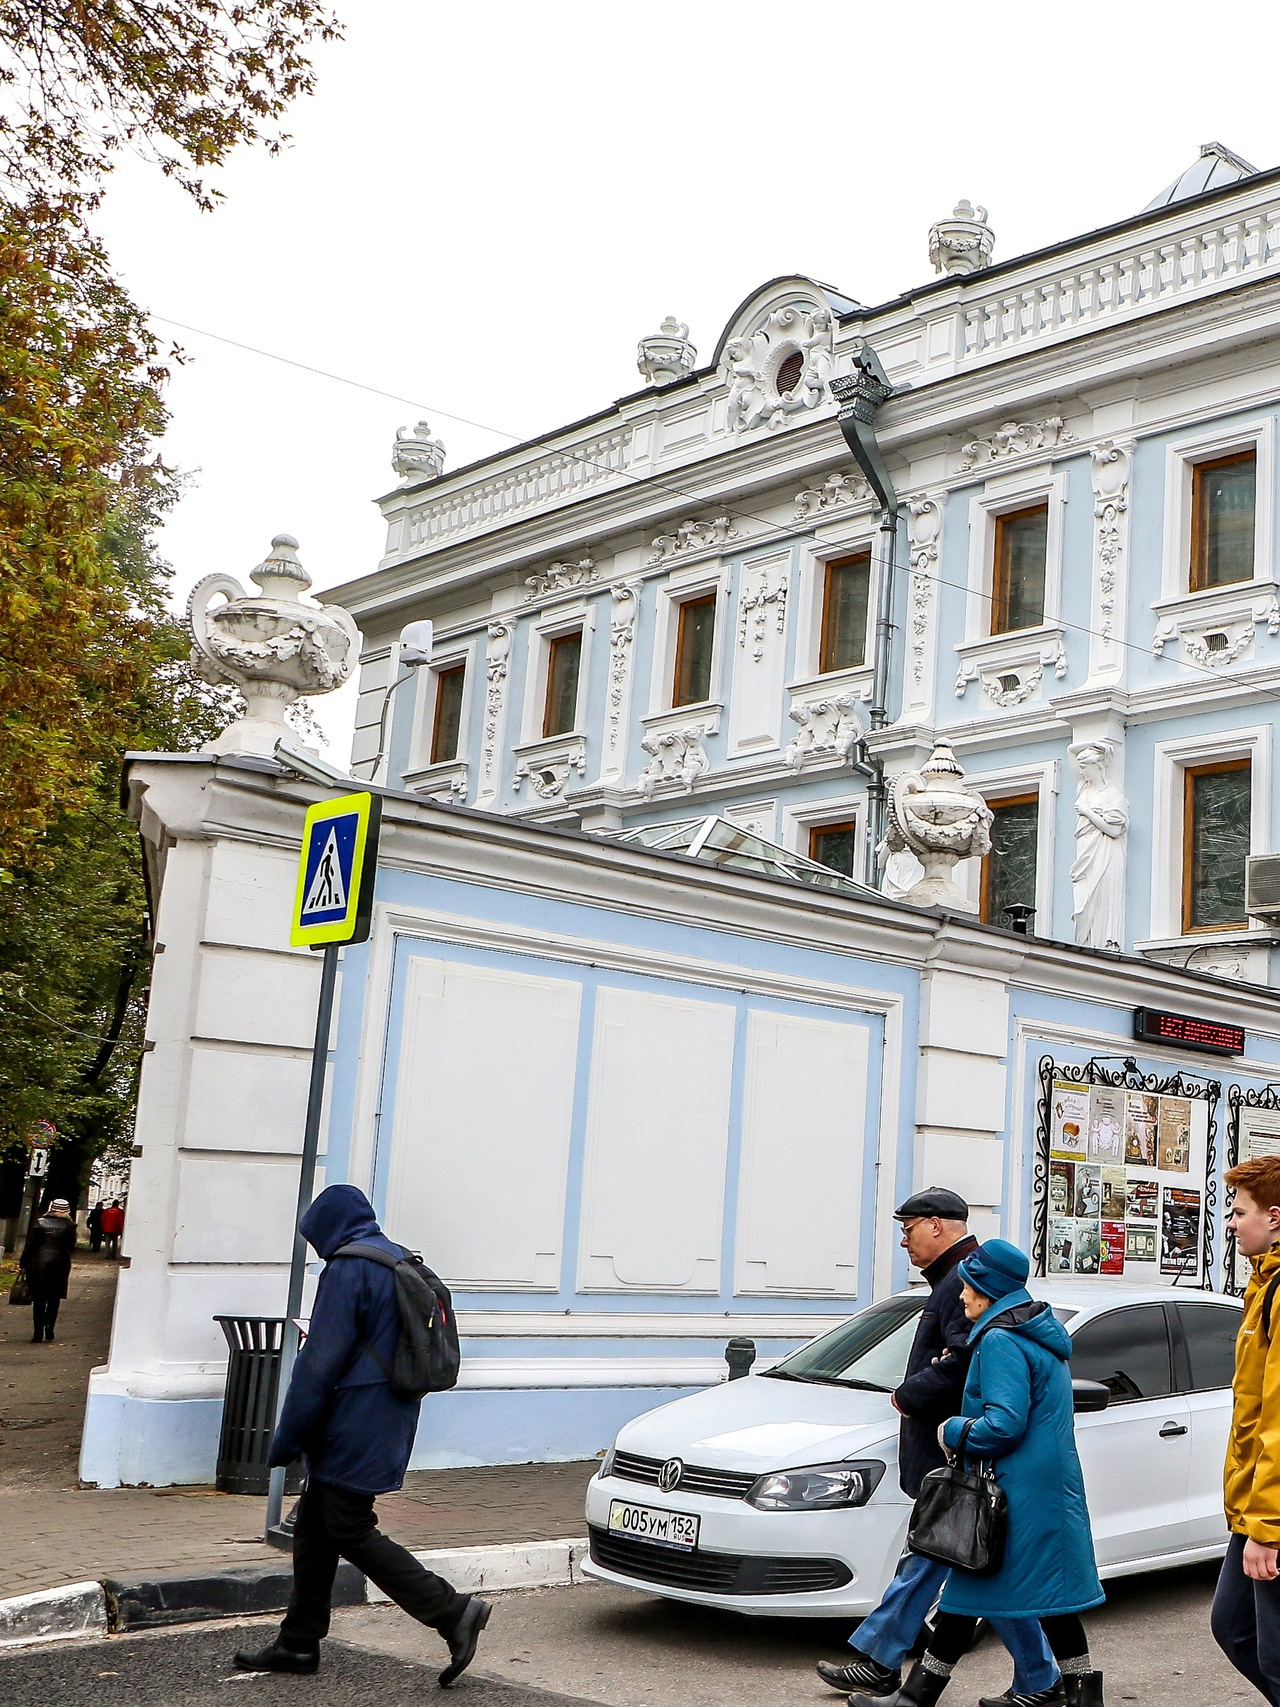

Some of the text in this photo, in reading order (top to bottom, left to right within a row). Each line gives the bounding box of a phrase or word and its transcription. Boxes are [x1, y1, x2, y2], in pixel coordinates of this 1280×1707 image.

[618, 1507, 693, 1537] 005УМ 152
[673, 1533, 685, 1542] RUS
